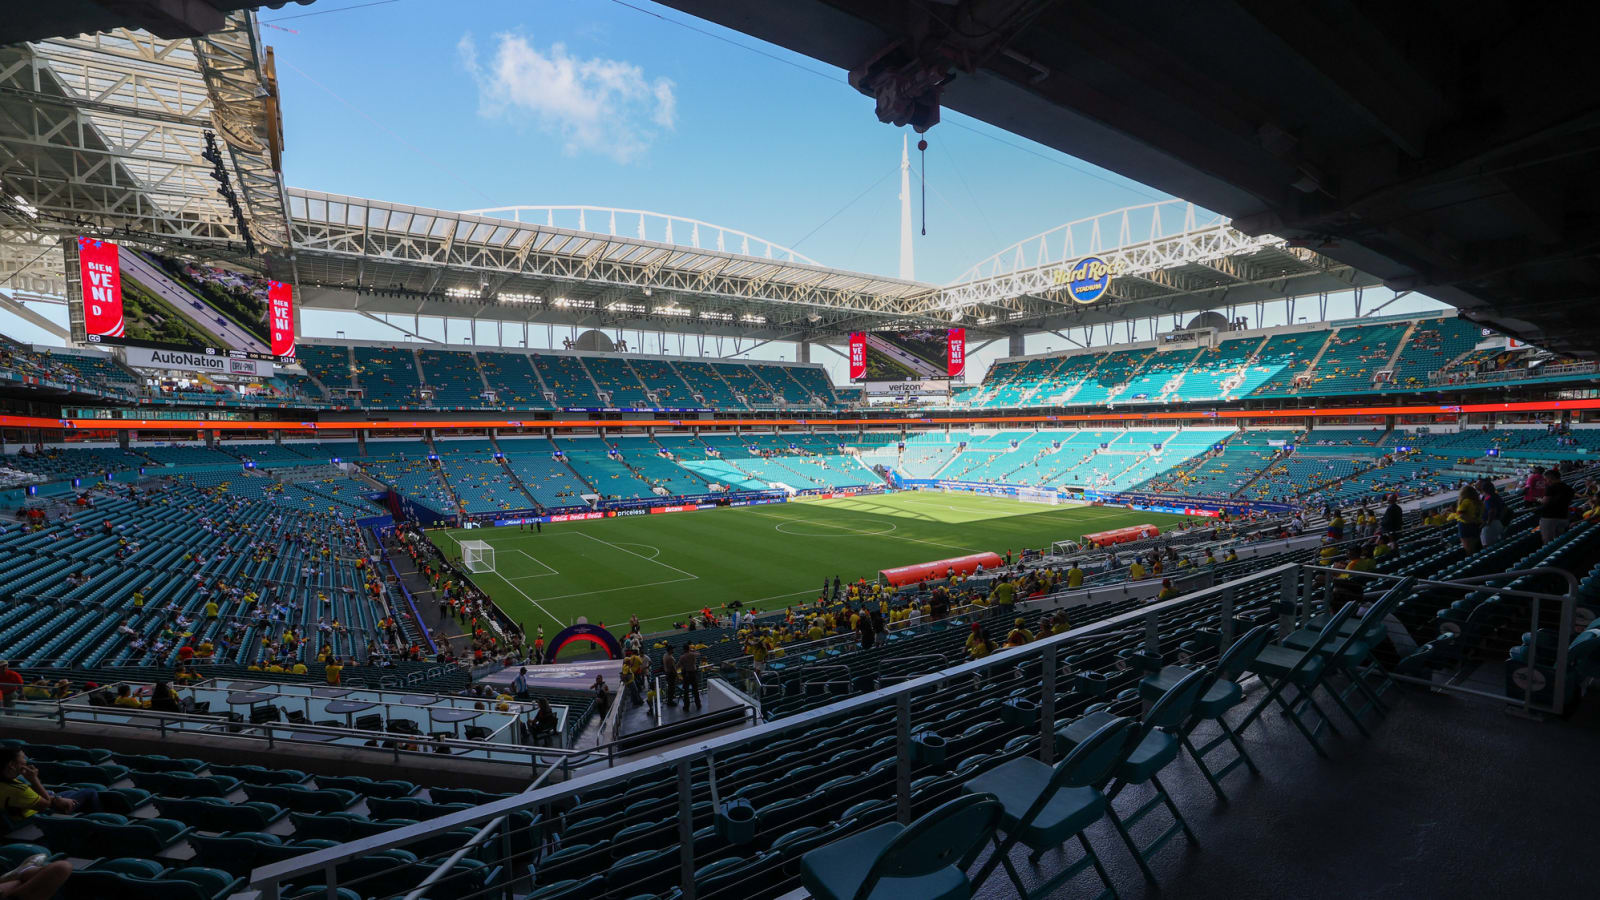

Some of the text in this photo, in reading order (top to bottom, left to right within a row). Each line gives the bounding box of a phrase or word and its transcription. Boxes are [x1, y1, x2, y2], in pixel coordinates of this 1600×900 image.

[88, 261, 112, 273] BIEN
[1053, 261, 1126, 284] Hard Rock
[89, 271, 113, 288] VE
[1076, 283, 1102, 294] STADIUM
[92, 287, 113, 303] NI
[92, 305, 102, 316] D
[274, 306, 289, 319] VE
[275, 319, 289, 330] NI
[151, 350, 224, 369] AutoNation
[889, 382, 921, 391] verizon
[617, 509, 646, 517] priceless
